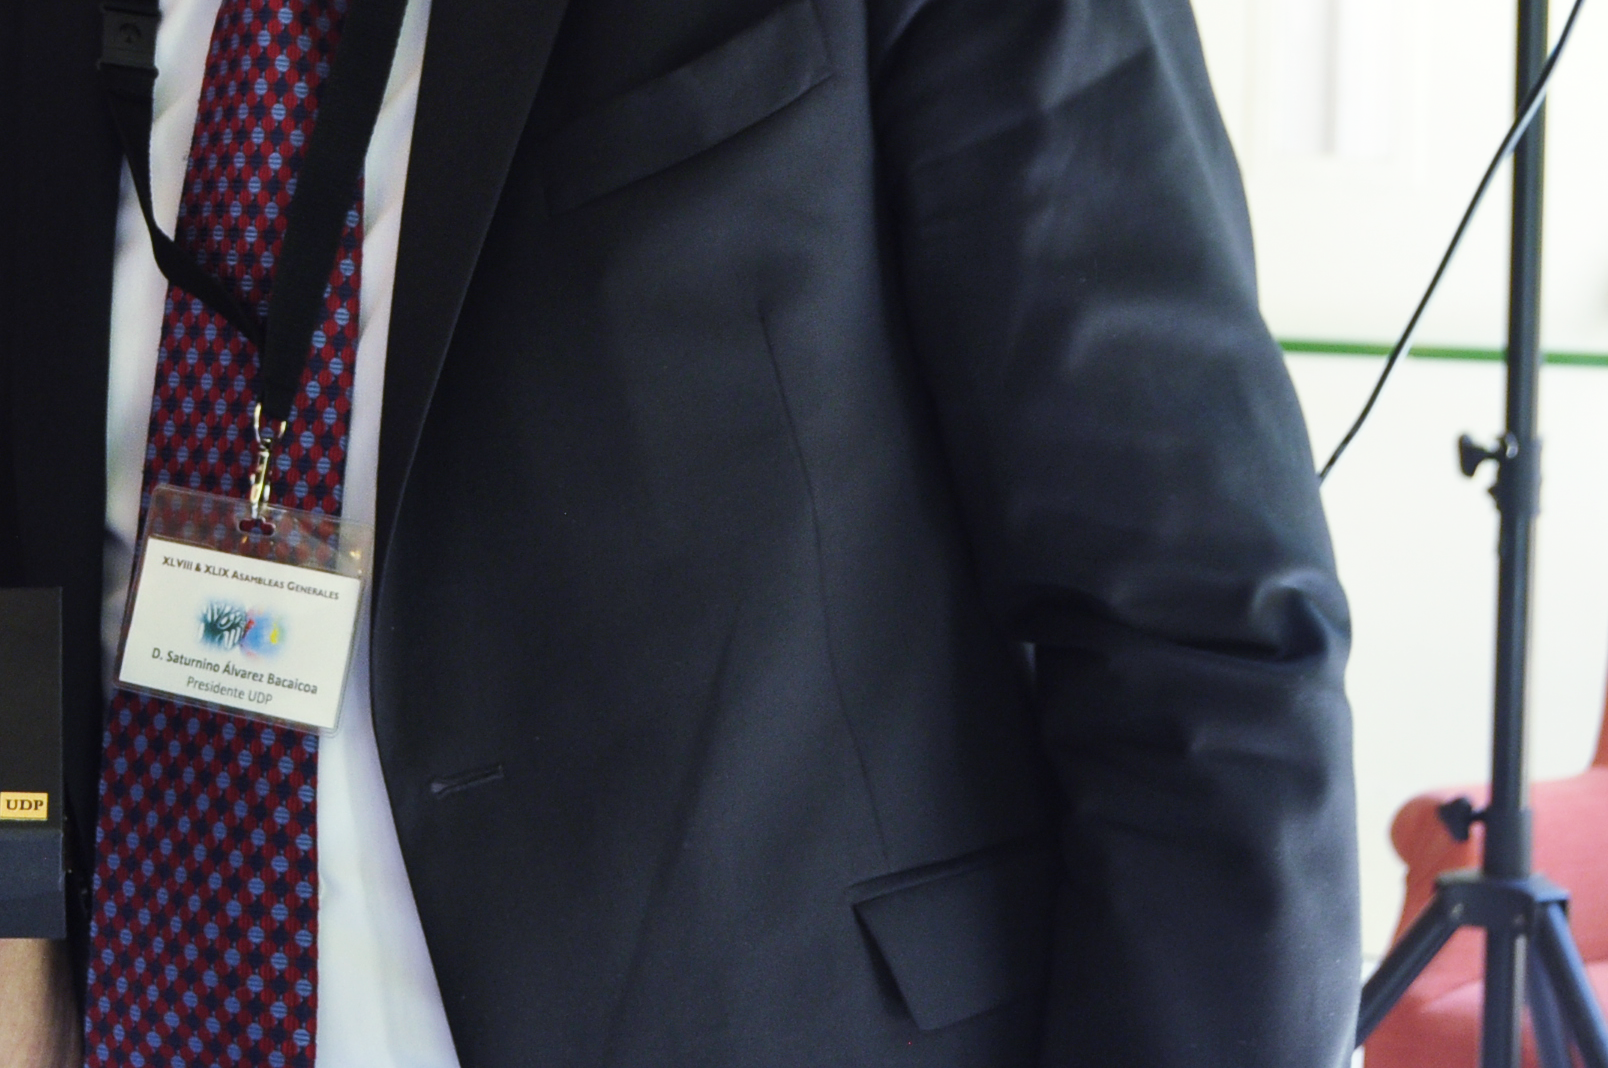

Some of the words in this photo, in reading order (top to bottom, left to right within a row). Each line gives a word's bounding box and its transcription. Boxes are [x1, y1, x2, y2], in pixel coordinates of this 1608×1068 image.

[194, 562, 202, 572] &
[203, 564, 230, 579] XLIX
[152, 647, 164, 661] D.
[165, 650, 221, 673] Saturnino
[222, 660, 265, 683] Álvarez
[266, 672, 319, 695] Bacaicoa
[186, 675, 246, 700] Presidente
[248, 689, 274, 705] UDP
[5, 798, 45, 811] UDP
